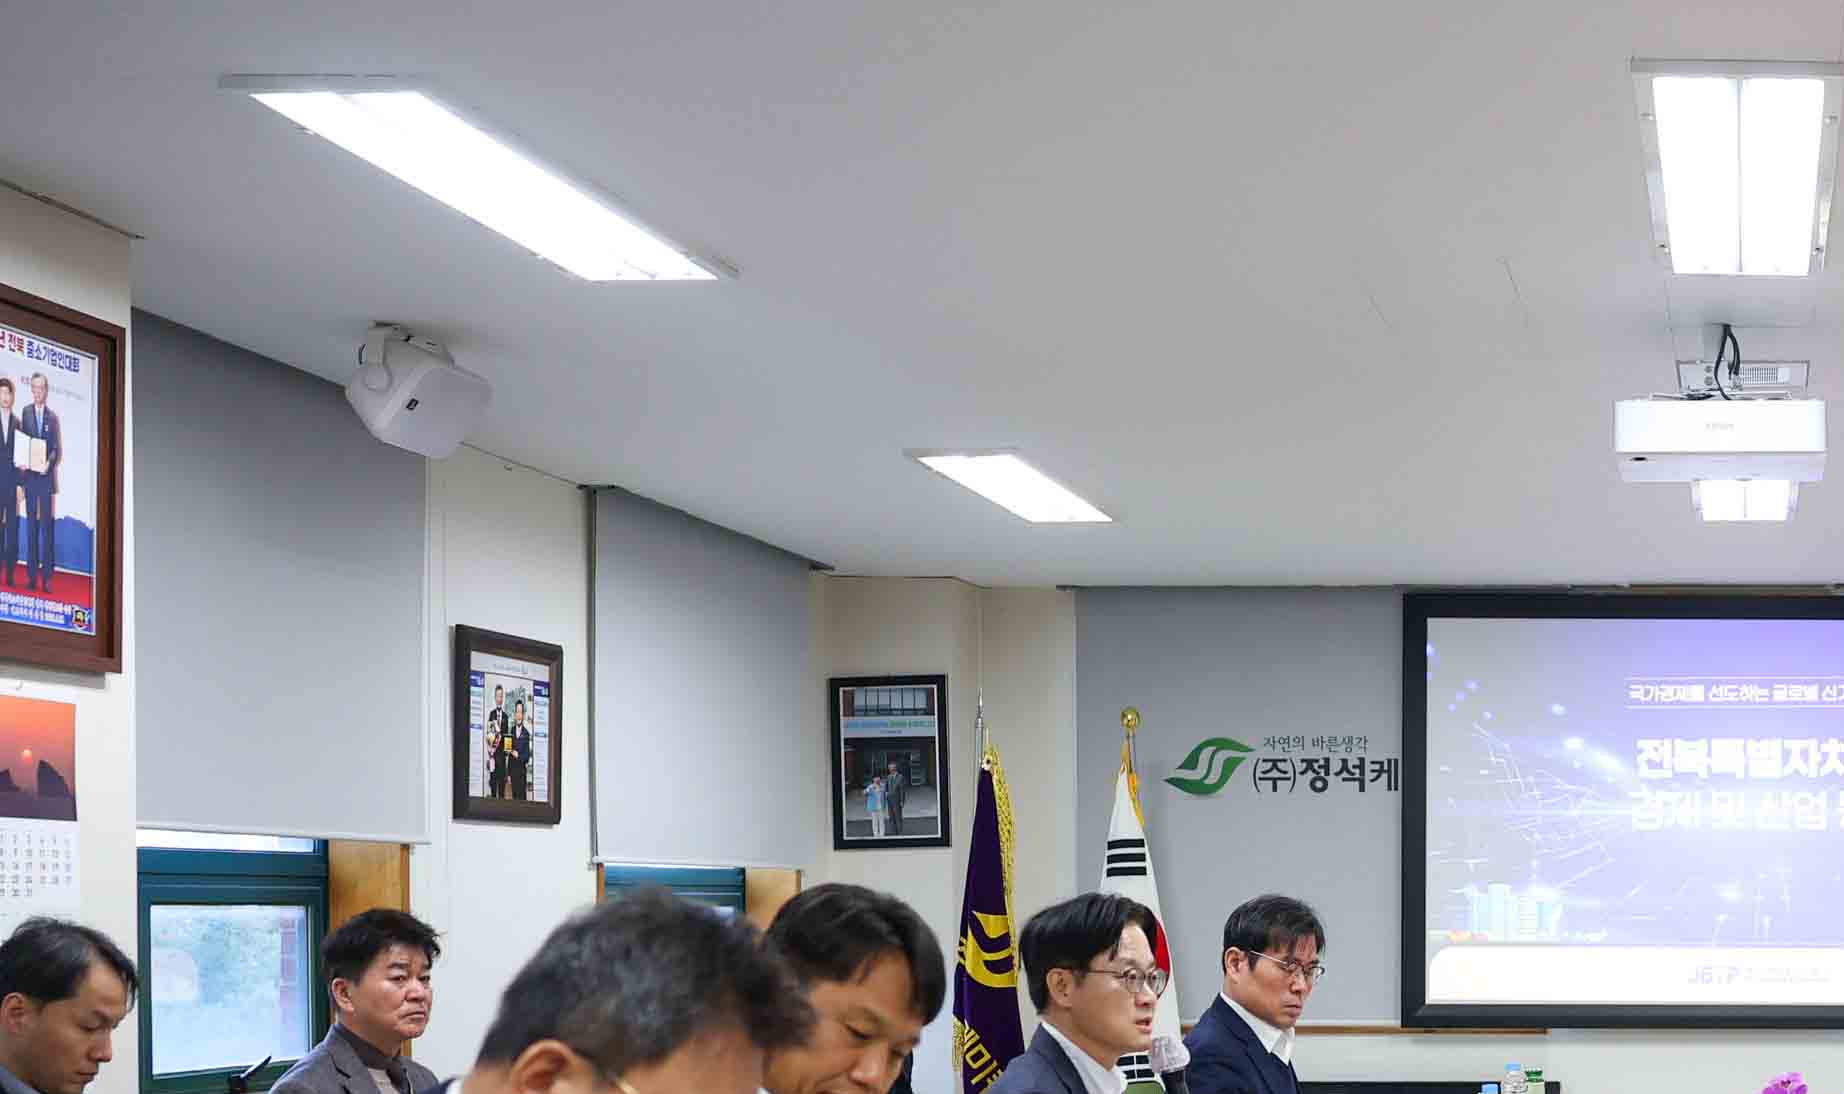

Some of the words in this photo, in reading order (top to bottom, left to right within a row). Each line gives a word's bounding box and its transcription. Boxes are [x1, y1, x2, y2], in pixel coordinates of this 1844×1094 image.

[1709, 684, 1769, 702] 선도하는
[1774, 684, 1819, 702] 글로벌
[1264, 736, 1305, 752] 자연의
[1312, 736, 1368, 753] 바른생각
[1629, 788, 1699, 831] 경제
[1711, 790, 1746, 831] 및
[1754, 789, 1828, 831] 산업
